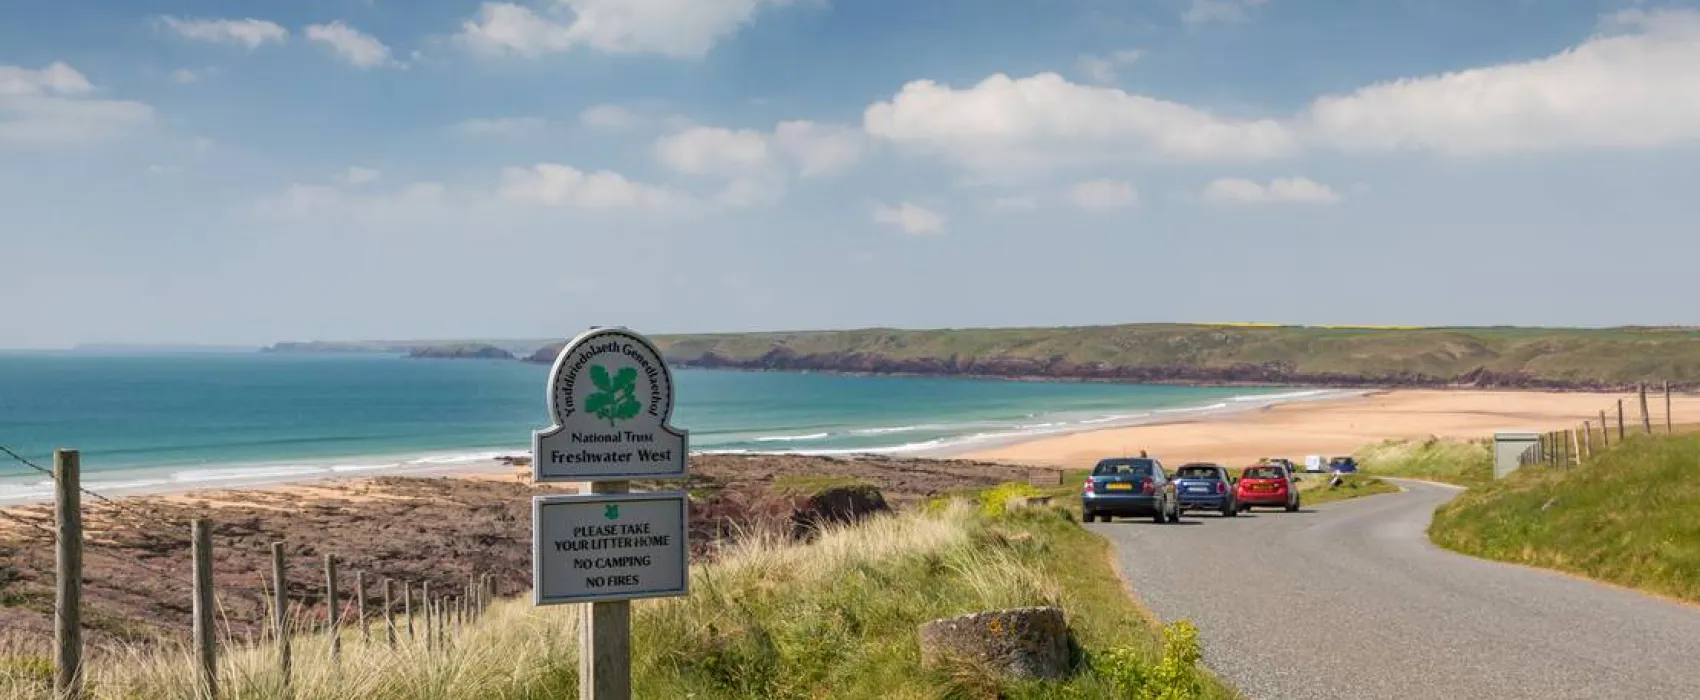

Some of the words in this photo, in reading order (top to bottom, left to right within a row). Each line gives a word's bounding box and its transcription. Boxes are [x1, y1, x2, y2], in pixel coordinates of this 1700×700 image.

[571, 432, 622, 443] National
[625, 432, 653, 442] Trust
[551, 450, 633, 463] Freshwater
[638, 450, 672, 461] West
[573, 525, 617, 537] PLEASE
[621, 523, 650, 535] TAKE
[555, 540, 589, 551] YOUR
[591, 538, 632, 550] LITTER
[634, 536, 671, 547] HOME
[574, 558, 593, 569] NO
[595, 556, 651, 568] CAMPING
[586, 576, 605, 588] NO
[608, 576, 640, 586] FIRES
